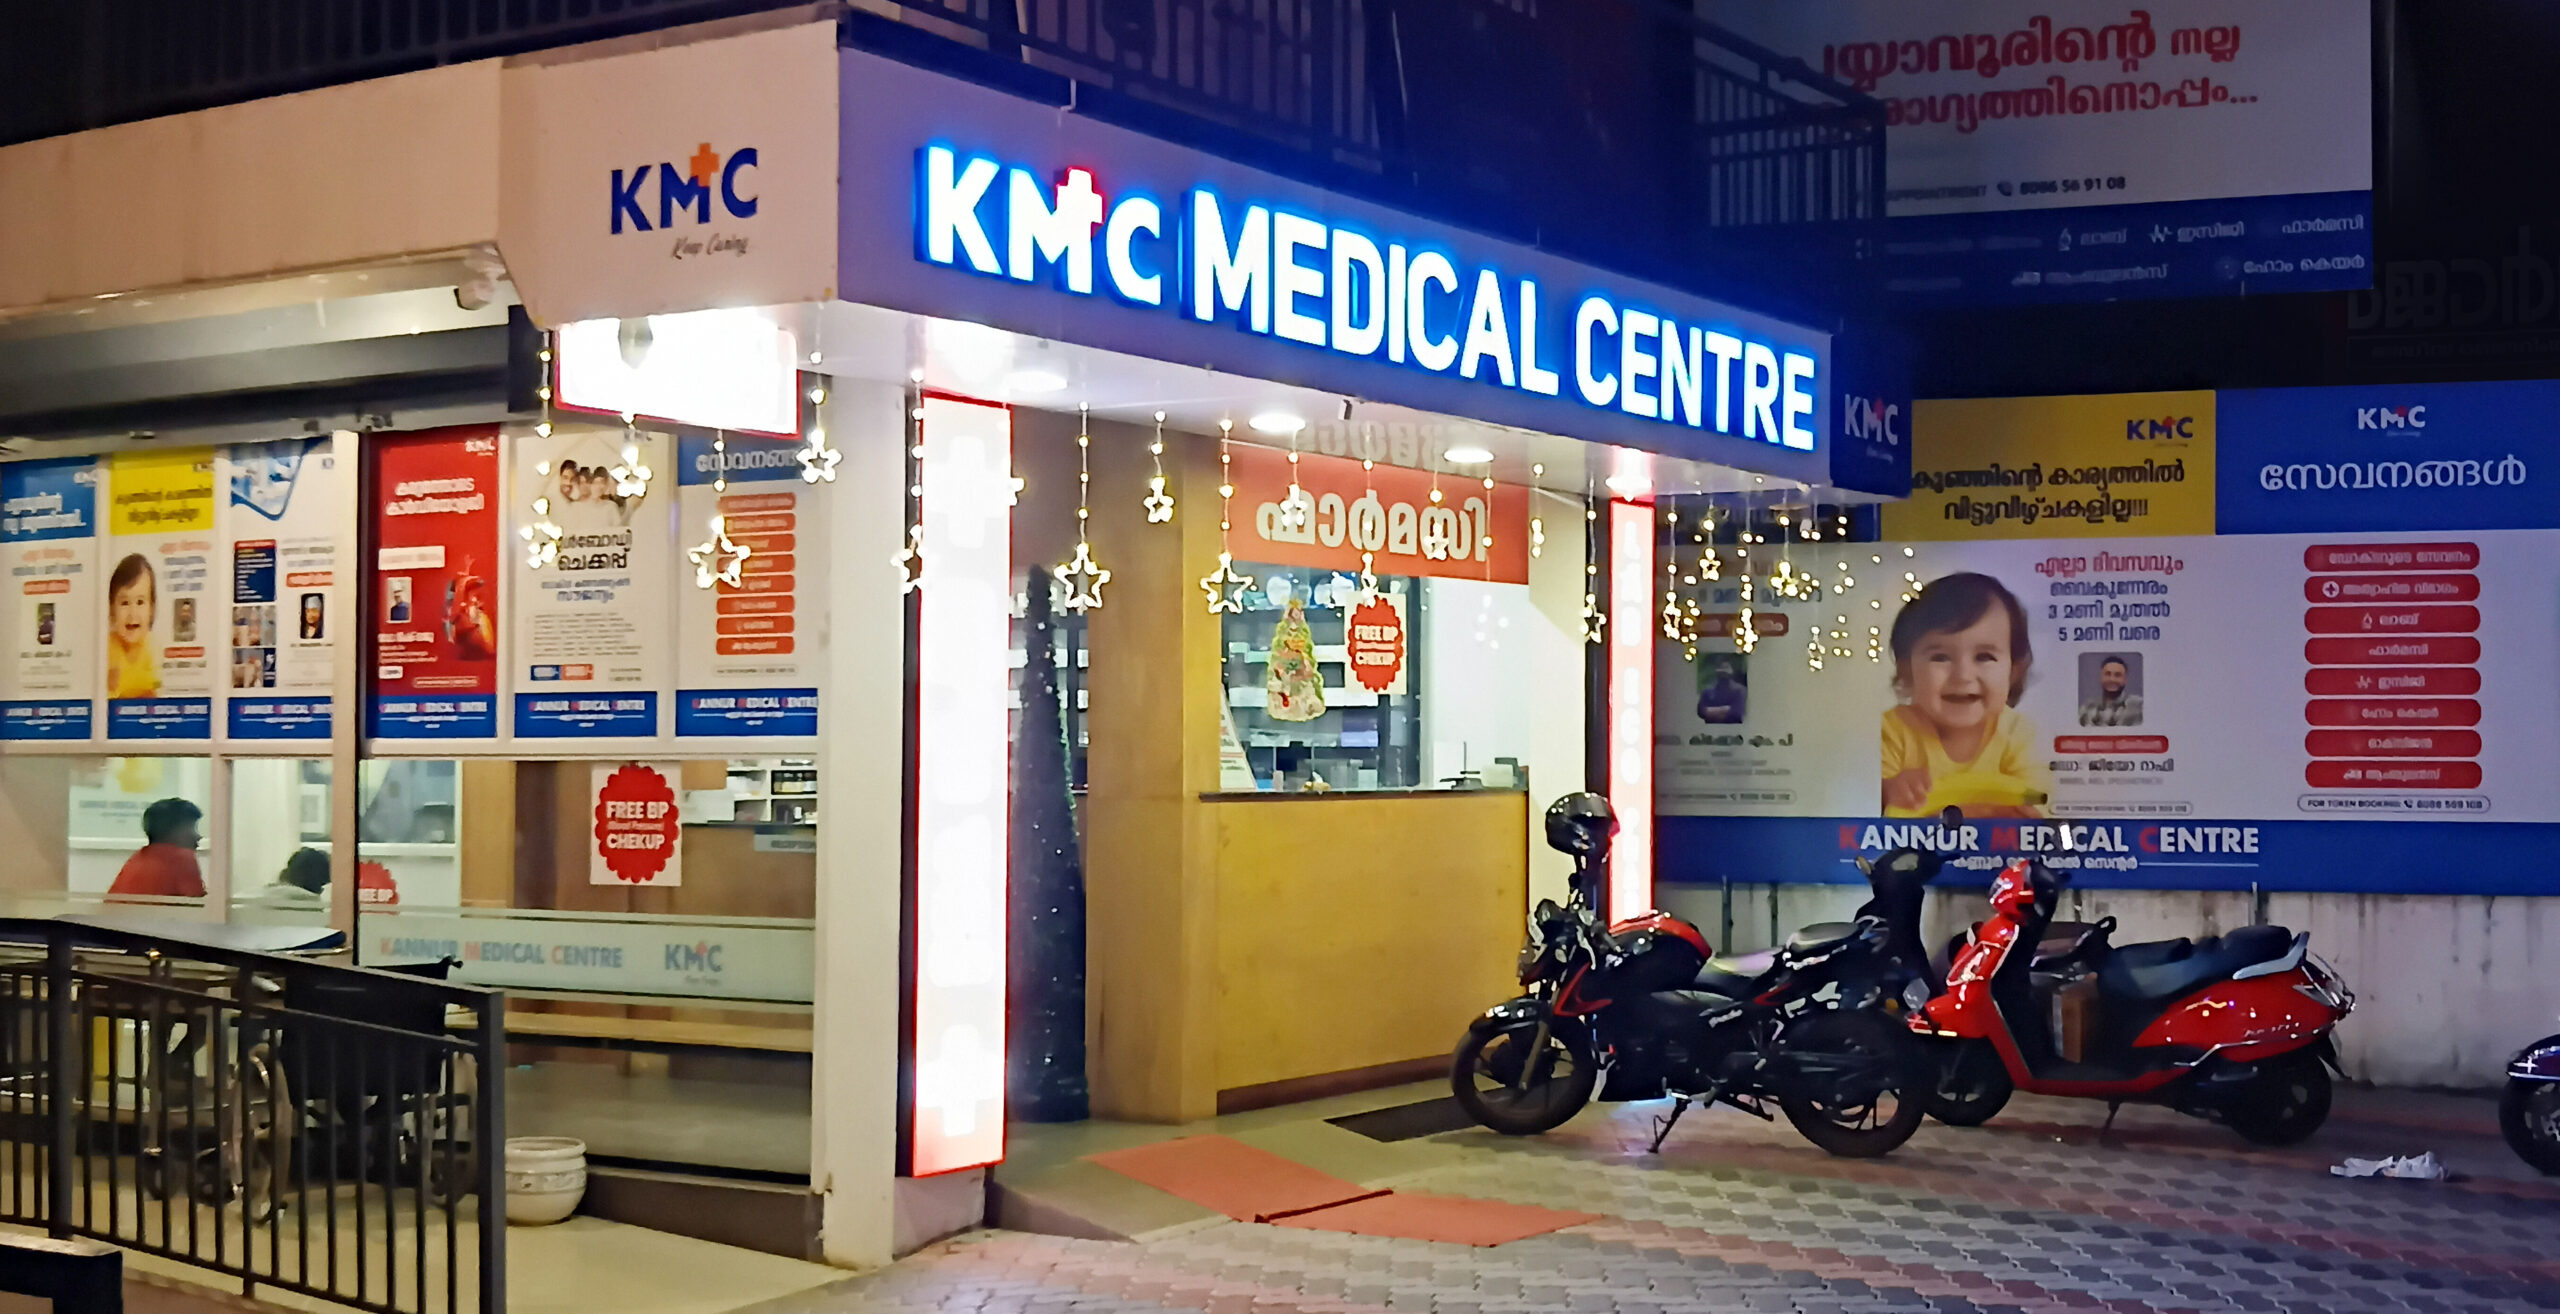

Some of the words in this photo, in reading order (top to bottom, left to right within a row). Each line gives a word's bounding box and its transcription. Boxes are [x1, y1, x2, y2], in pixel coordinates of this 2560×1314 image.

[610, 143, 758, 235] KMC
[2084, 177, 2101, 190] 91
[918, 145, 1162, 308] KMC
[1186, 188, 1560, 397] MEDICAL
[1574, 296, 1816, 452] CENTRE
[1844, 393, 1899, 446] KMC
[2127, 415, 2194, 441] KMC
[2357, 404, 2426, 430] KMC
[2260, 453, 2526, 491] സേവനങ്ങൾ
[1256, 489, 1489, 562] ഫാർമസി
[606, 801, 645, 819] FREE
[646, 801, 669, 819] BP
[606, 833, 665, 850] CHEKUP
[1838, 824, 1980, 852] KANNUR
[2138, 826, 2260, 854] CENTRE
[464, 940, 545, 964] MEDICAL
[552, 945, 623, 969] CENTRE
[665, 942, 723, 973] KMC
